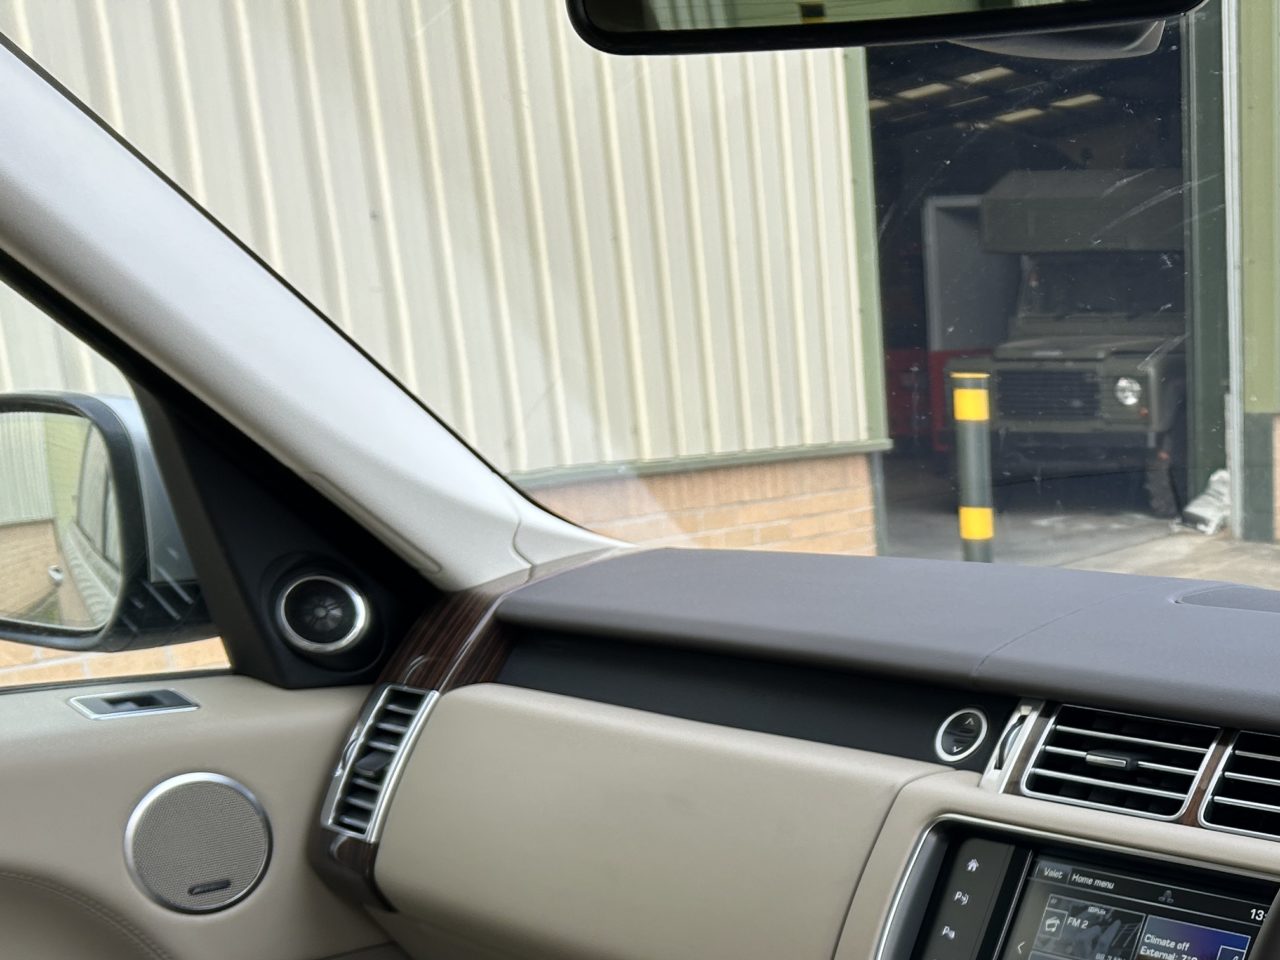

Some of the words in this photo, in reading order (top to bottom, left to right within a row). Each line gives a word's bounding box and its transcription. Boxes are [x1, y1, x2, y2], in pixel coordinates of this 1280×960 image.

[1043, 867, 1064, 881] Valet
[1071, 873, 1093, 887] Home
[1093, 879, 1115, 890] menu
[1066, 916, 1081, 928] FM
[1081, 919, 1089, 929] 2
[1143, 934, 1176, 951] Climate
[1176, 940, 1190, 953] off
